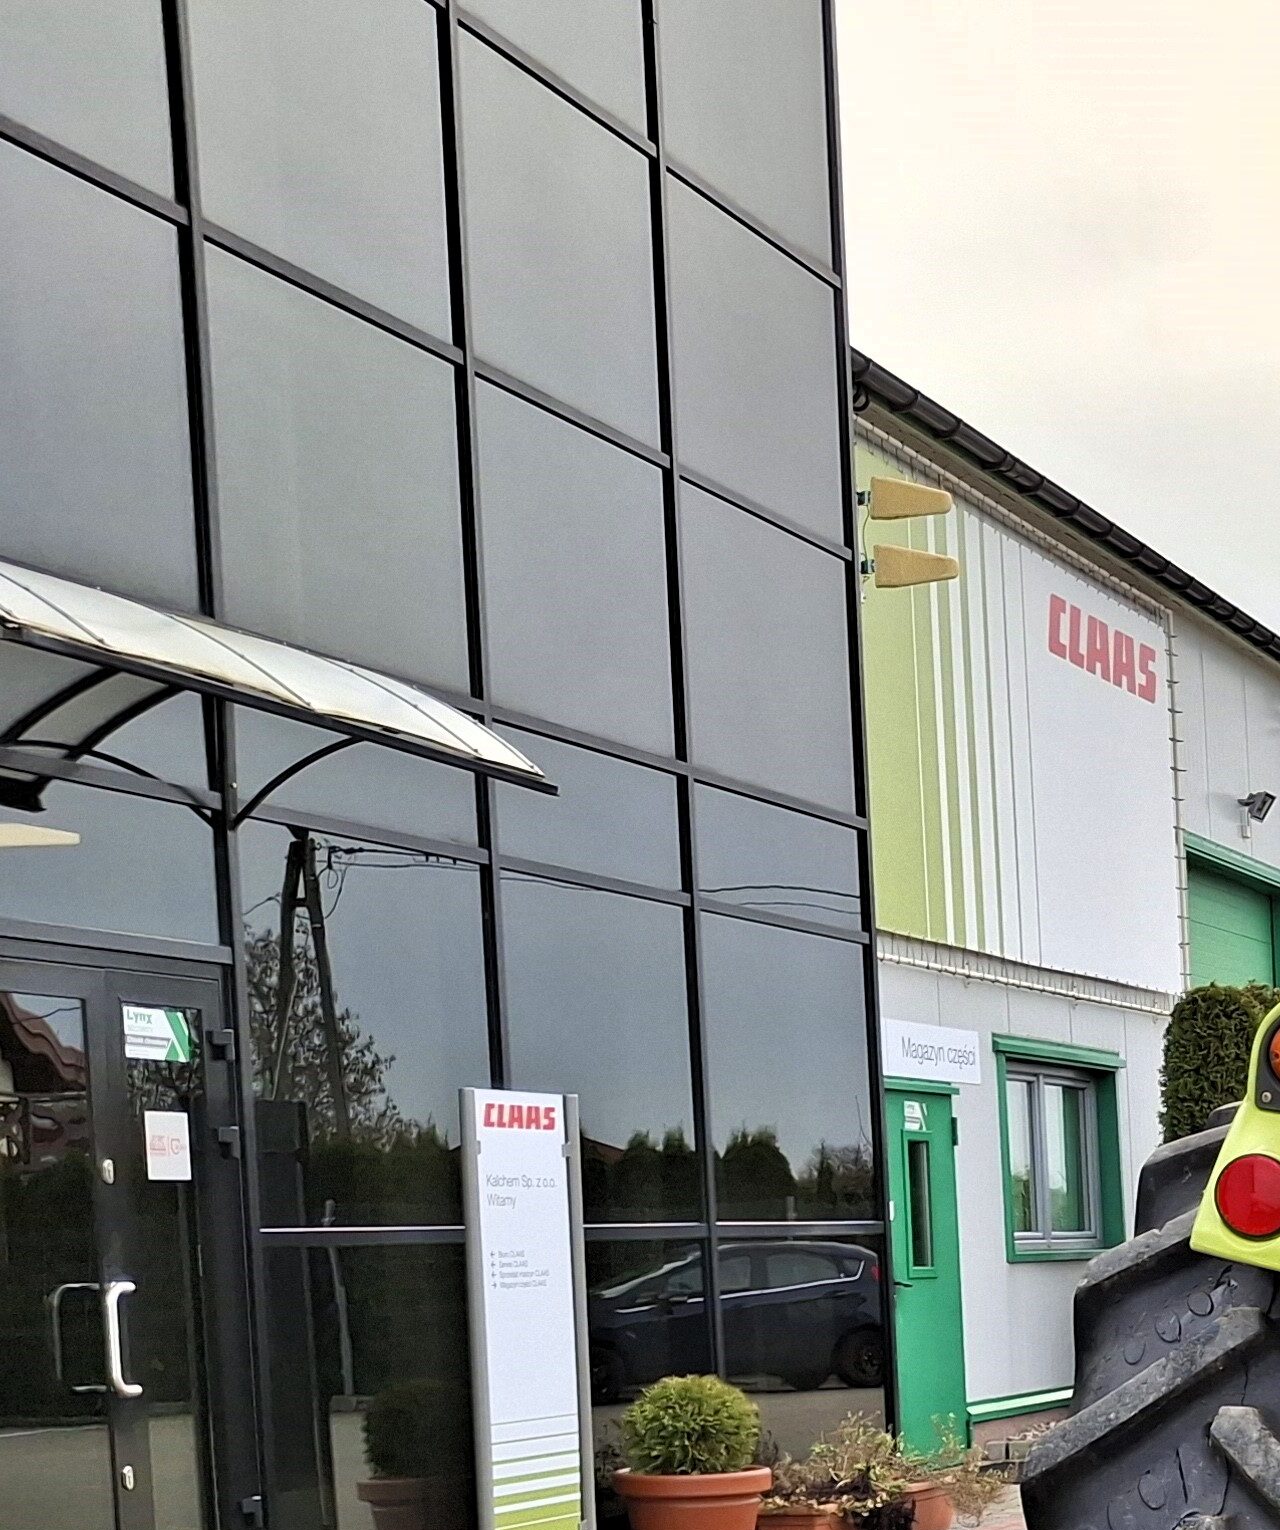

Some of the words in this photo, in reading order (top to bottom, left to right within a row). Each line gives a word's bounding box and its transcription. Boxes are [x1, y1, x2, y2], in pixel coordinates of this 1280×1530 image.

[1048, 593, 1157, 704] CLAAS
[126, 1008, 153, 1024] Lynx
[901, 1036, 945, 1067] Magazyn
[947, 1043, 976, 1070] części
[483, 1103, 556, 1130] CLAAS
